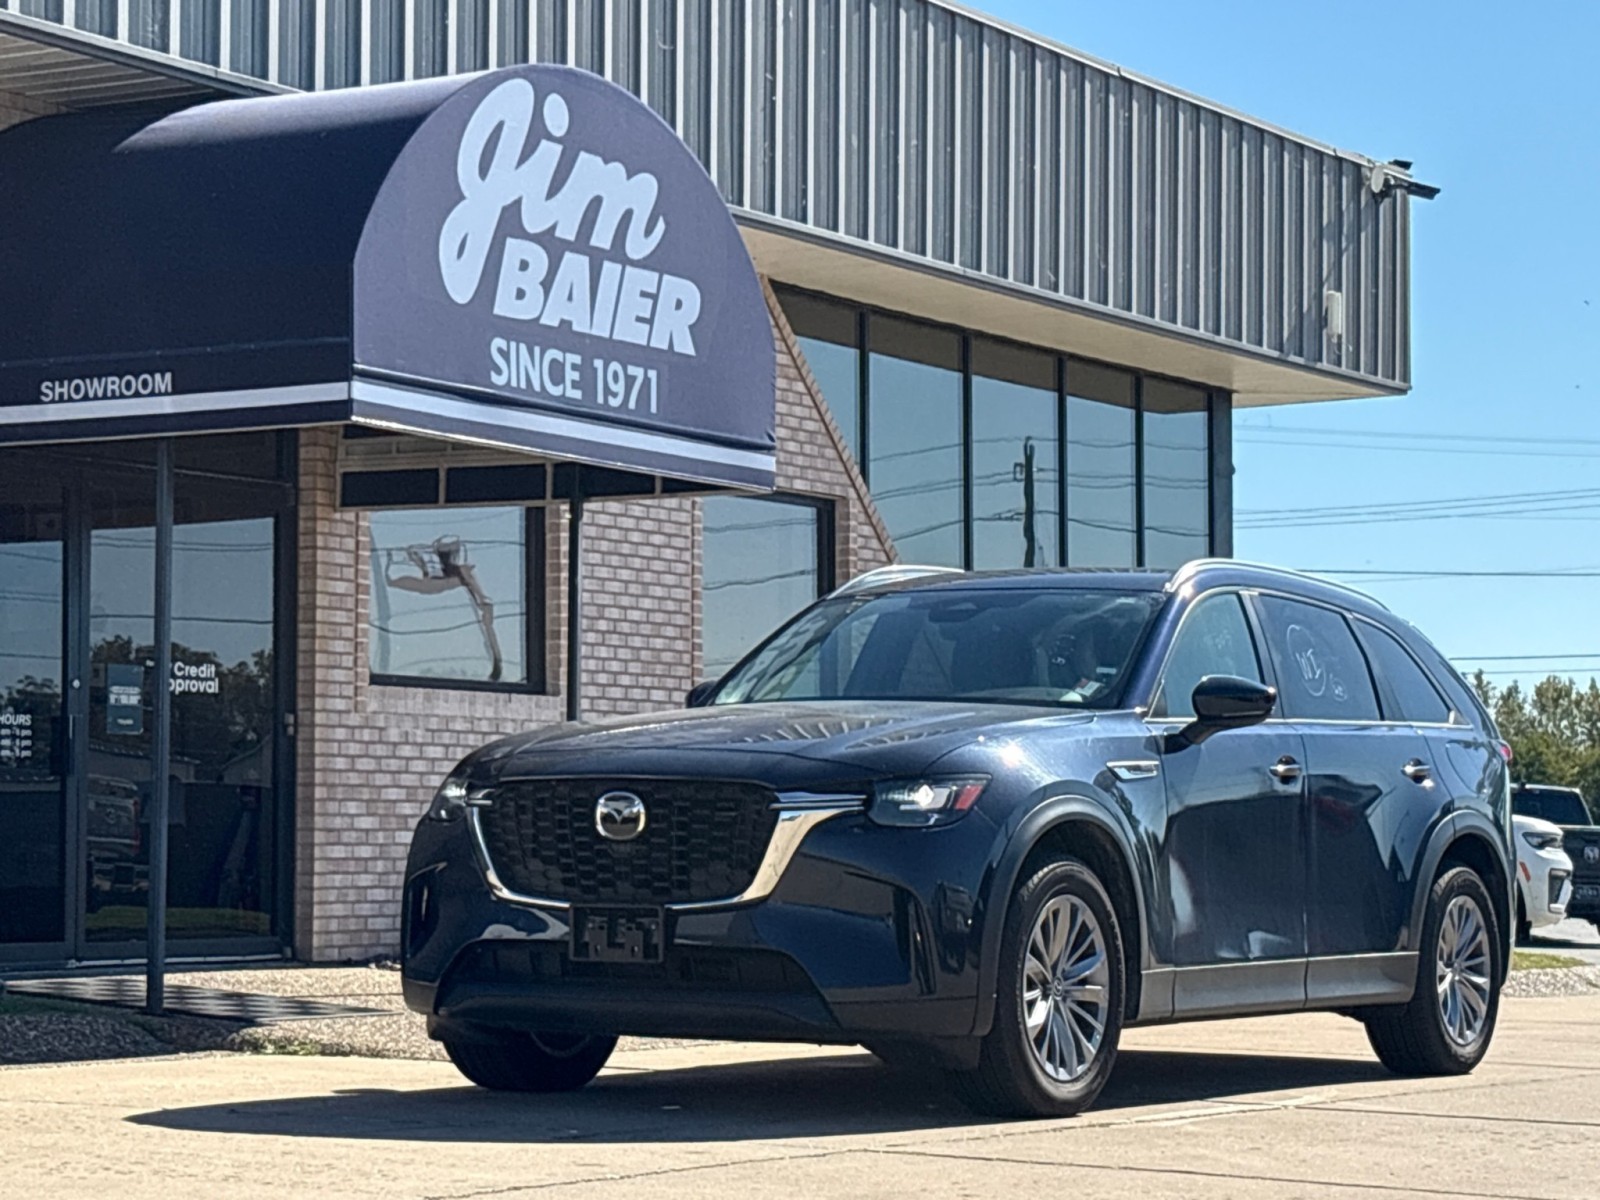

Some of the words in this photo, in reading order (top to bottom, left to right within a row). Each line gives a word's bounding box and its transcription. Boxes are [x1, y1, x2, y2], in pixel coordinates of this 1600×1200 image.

[439, 78, 666, 304] Jim
[493, 237, 701, 356] BAIER
[40, 371, 173, 402] SHOWROOM
[490, 336, 582, 400] SINCE
[593, 359, 657, 414] 1971
[168, 678, 219, 695] pproval
[174, 661, 216, 678] Credit
